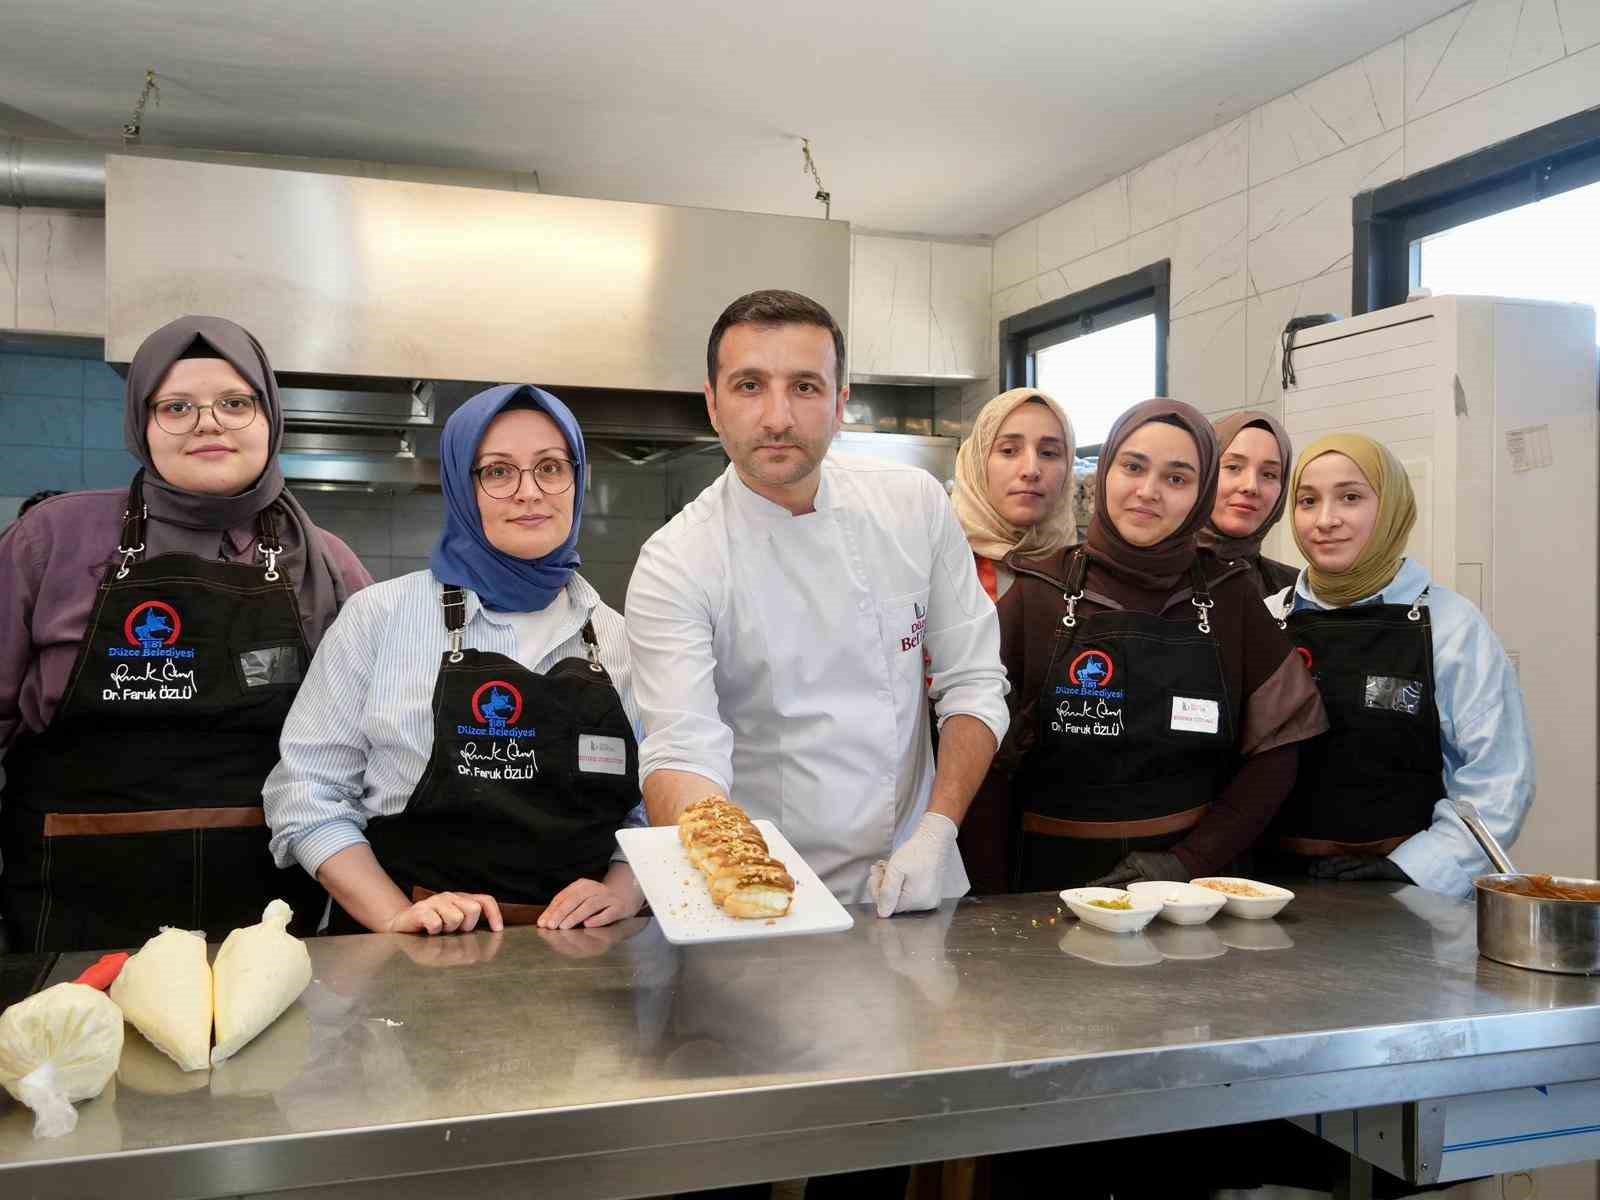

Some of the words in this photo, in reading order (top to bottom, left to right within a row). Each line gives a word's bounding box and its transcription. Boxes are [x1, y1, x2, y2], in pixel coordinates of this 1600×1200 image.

[108, 648, 140, 657] Düzce
[143, 647, 194, 658] Belediyesi
[103, 688, 120, 700] Dr.
[123, 688, 157, 700] Faruk
[159, 684, 192, 700] ÖZLÜ
[1056, 686, 1079, 695] Düzce
[1081, 687, 1123, 699] Belediyesi
[457, 725, 488, 735] Düzce
[488, 726, 536, 737] Belediyesi
[1051, 721, 1064, 732] Dr.
[1065, 723, 1091, 735] Faruk
[1093, 722, 1120, 736] ÖZLÜ
[457, 764, 474, 776] Dr.
[474, 766, 502, 779] Faruk
[503, 764, 534, 779] ÖZLÜ
